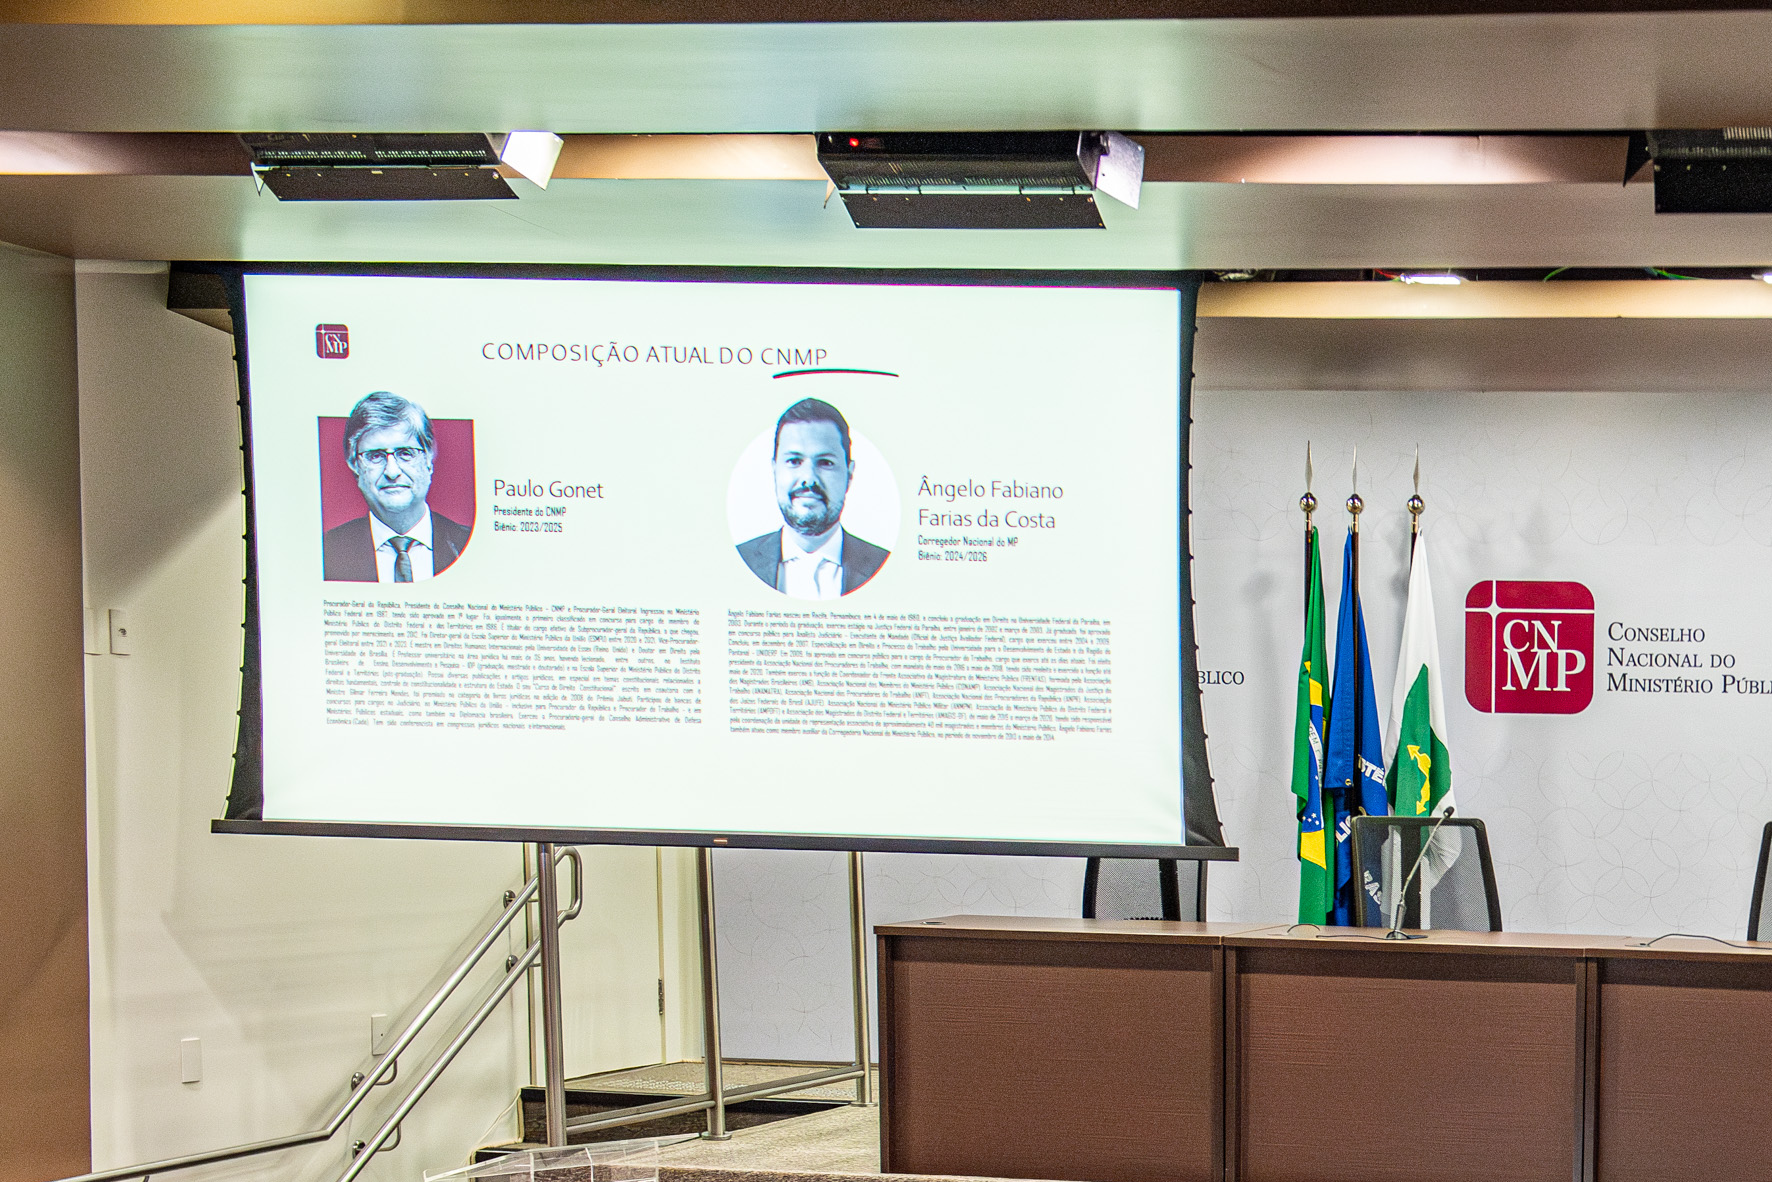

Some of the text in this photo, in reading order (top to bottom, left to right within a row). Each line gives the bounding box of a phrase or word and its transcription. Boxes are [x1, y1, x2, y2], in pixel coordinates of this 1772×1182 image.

[482, 341, 827, 367] COMPOSIÇÃO ATUAL DO CNMP
[494, 479, 603, 498] Paulo Gonet
[918, 475, 1064, 502] Ângelo Fabiano
[493, 505, 567, 517] Presidente do CNMP
[919, 509, 1055, 528] Farias da Costa
[520, 522, 562, 532] 2023/2025
[918, 535, 1019, 548] Corregedor Nacional do MP
[945, 551, 987, 561] 2024/2026
